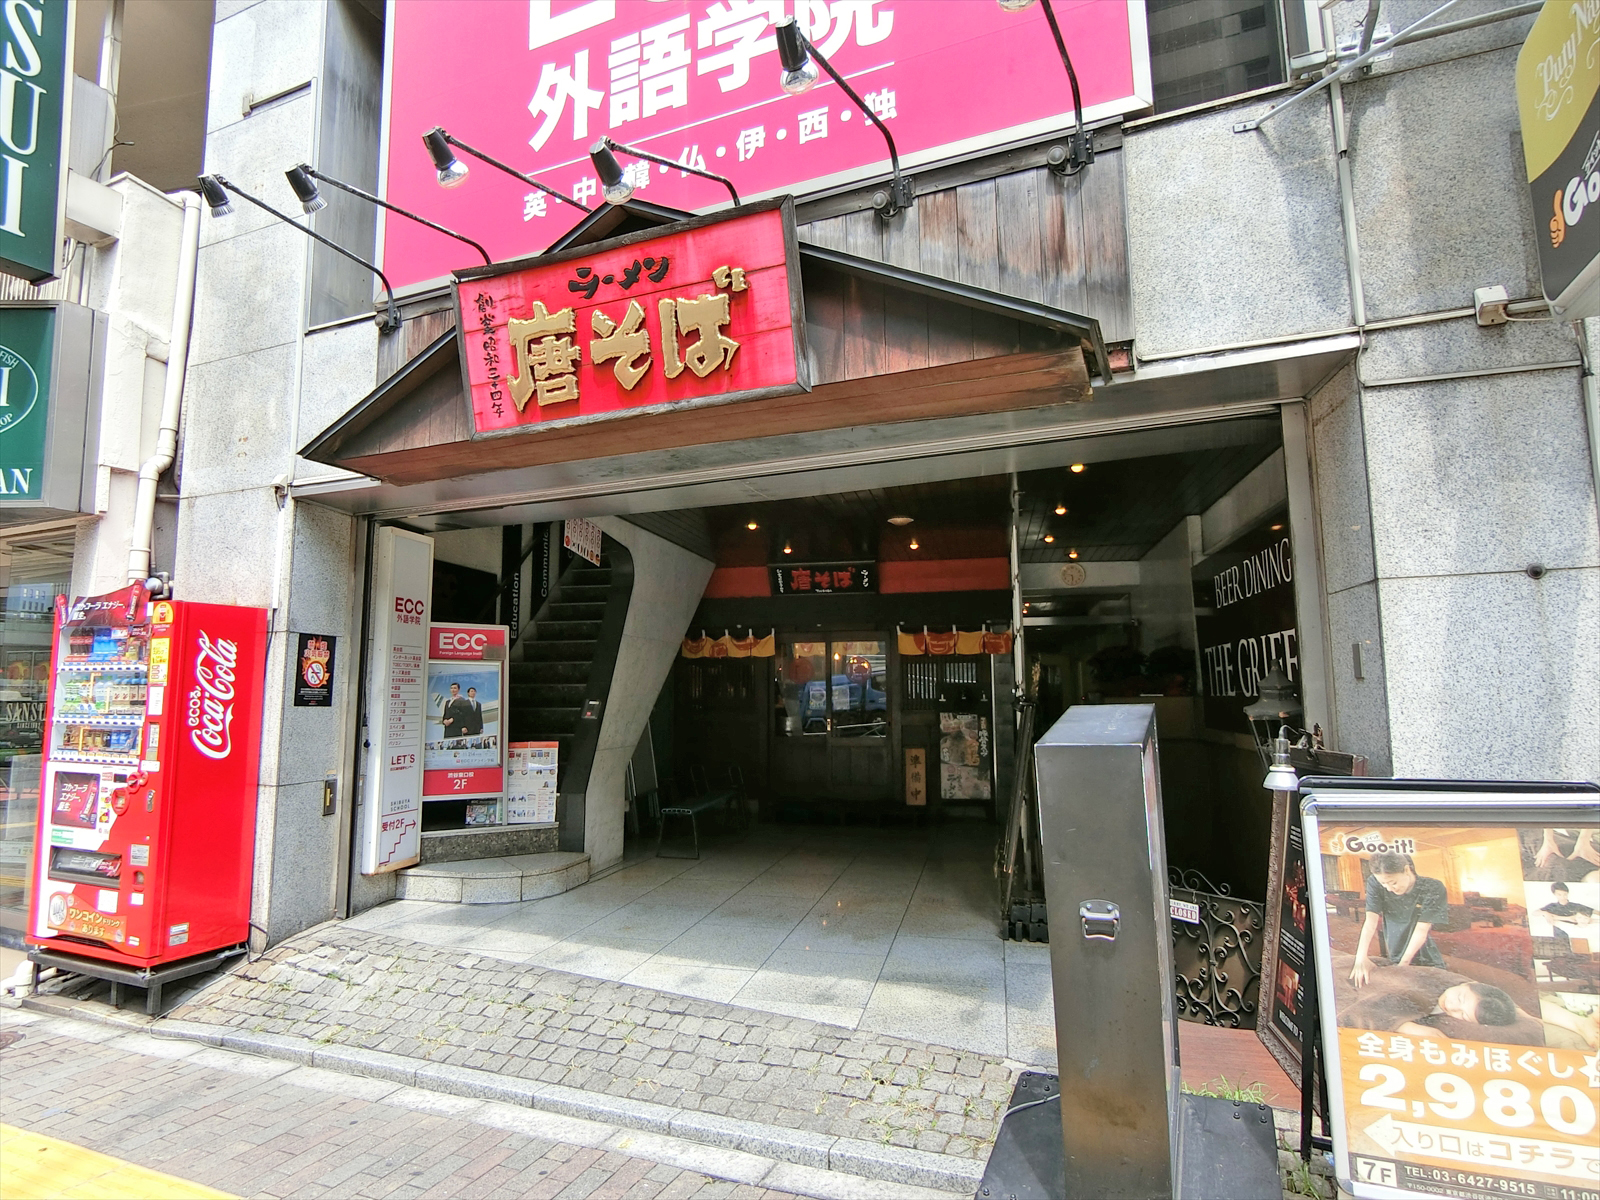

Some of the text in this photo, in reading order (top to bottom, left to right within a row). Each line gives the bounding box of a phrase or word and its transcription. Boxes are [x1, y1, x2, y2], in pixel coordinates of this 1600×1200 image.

[568, 256, 669, 299] ラーメン
[507, 265, 749, 413] 唐そば
[541, 529, 549, 597] Communic
[790, 566, 856, 590] 唐そば
[1214, 537, 1292, 609] BEER DINING
[395, 596, 425, 615] ECC
[511, 573, 520, 638] Education
[439, 632, 488, 651] ECC
[1204, 643, 1236, 697] THE
[191, 629, 238, 759] Coca-Cola
[454, 779, 468, 791] 2F
[1346, 836, 1414, 855] Goo-it!
[1170, 906, 1198, 921] CLOSED
[1357, 1031, 1575, 1079] 全身もみほぐし
[1358, 1062, 1597, 1138] 2,980
[1362, 1163, 1393, 1184] 7F
